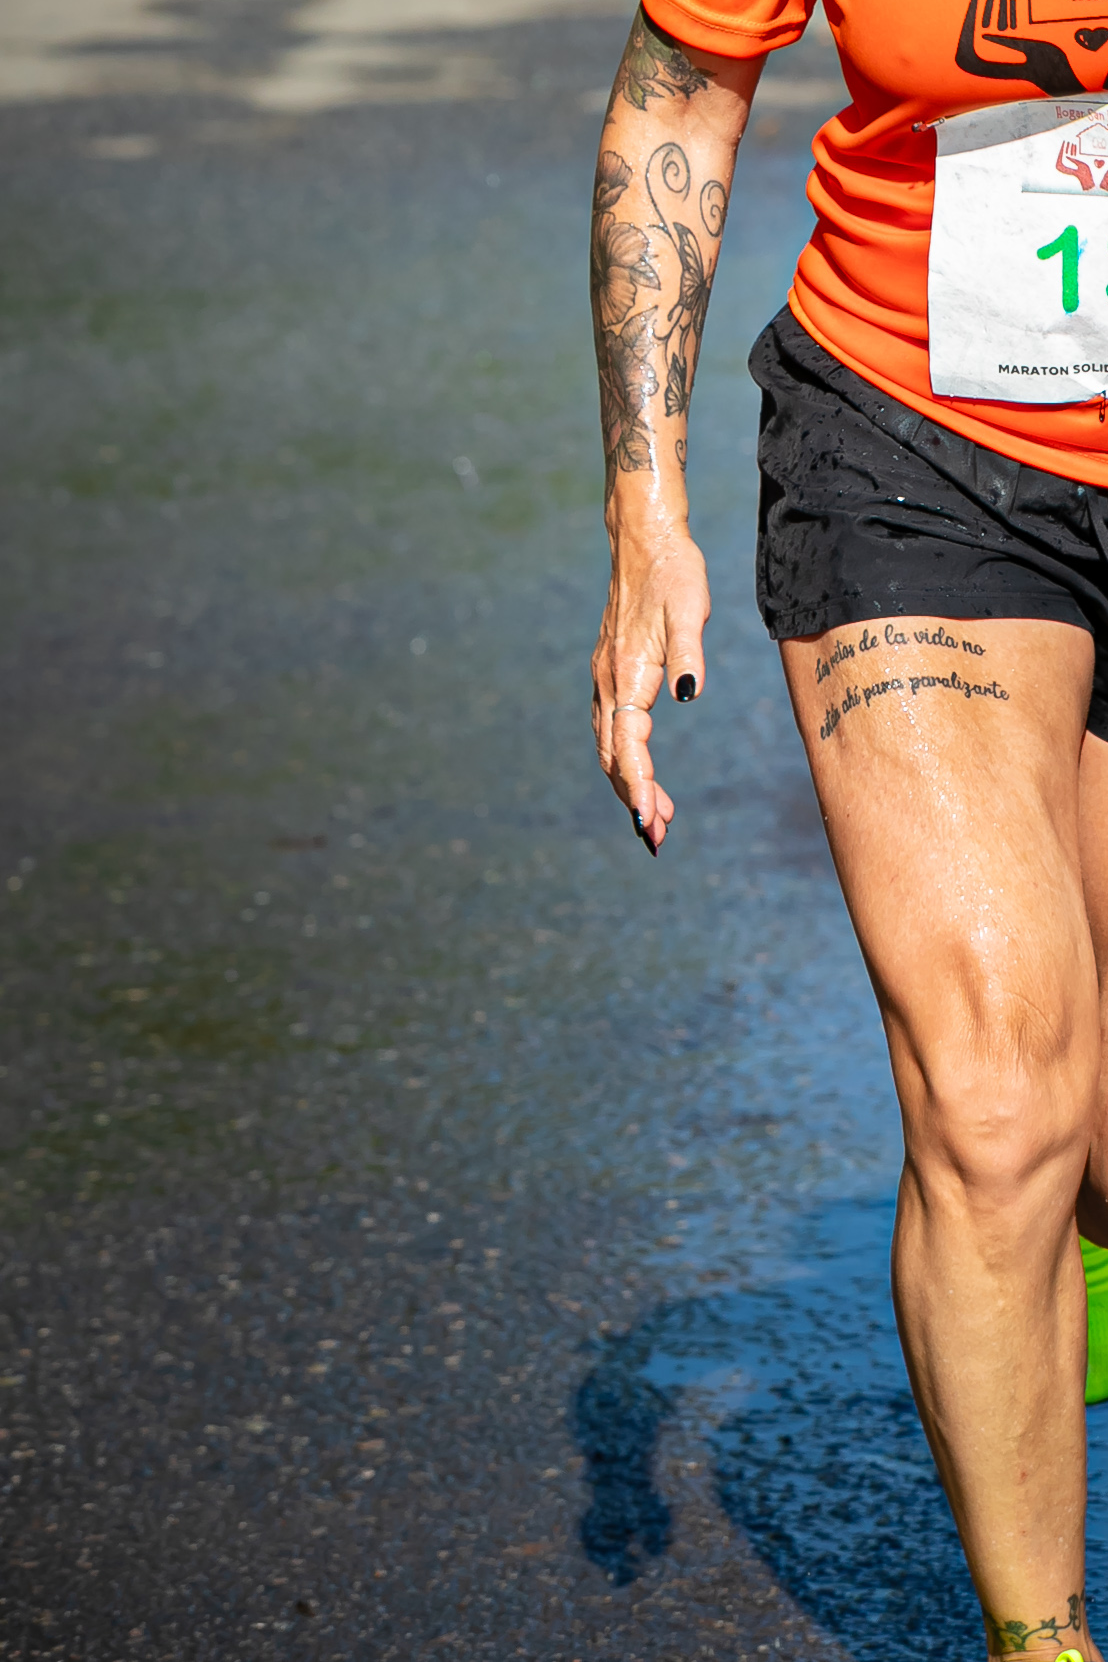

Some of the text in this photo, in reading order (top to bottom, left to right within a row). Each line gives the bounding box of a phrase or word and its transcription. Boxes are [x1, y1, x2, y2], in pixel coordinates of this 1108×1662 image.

[1055, 105, 1085, 122] Hogar
[1087, 107, 1105, 122] San
[998, 364, 1069, 376] MARATON
[859, 628, 880, 652] de
[884, 624, 909, 646] la
[913, 626, 959, 650] vida
[961, 640, 987, 656] no
[862, 678, 905, 708] para
